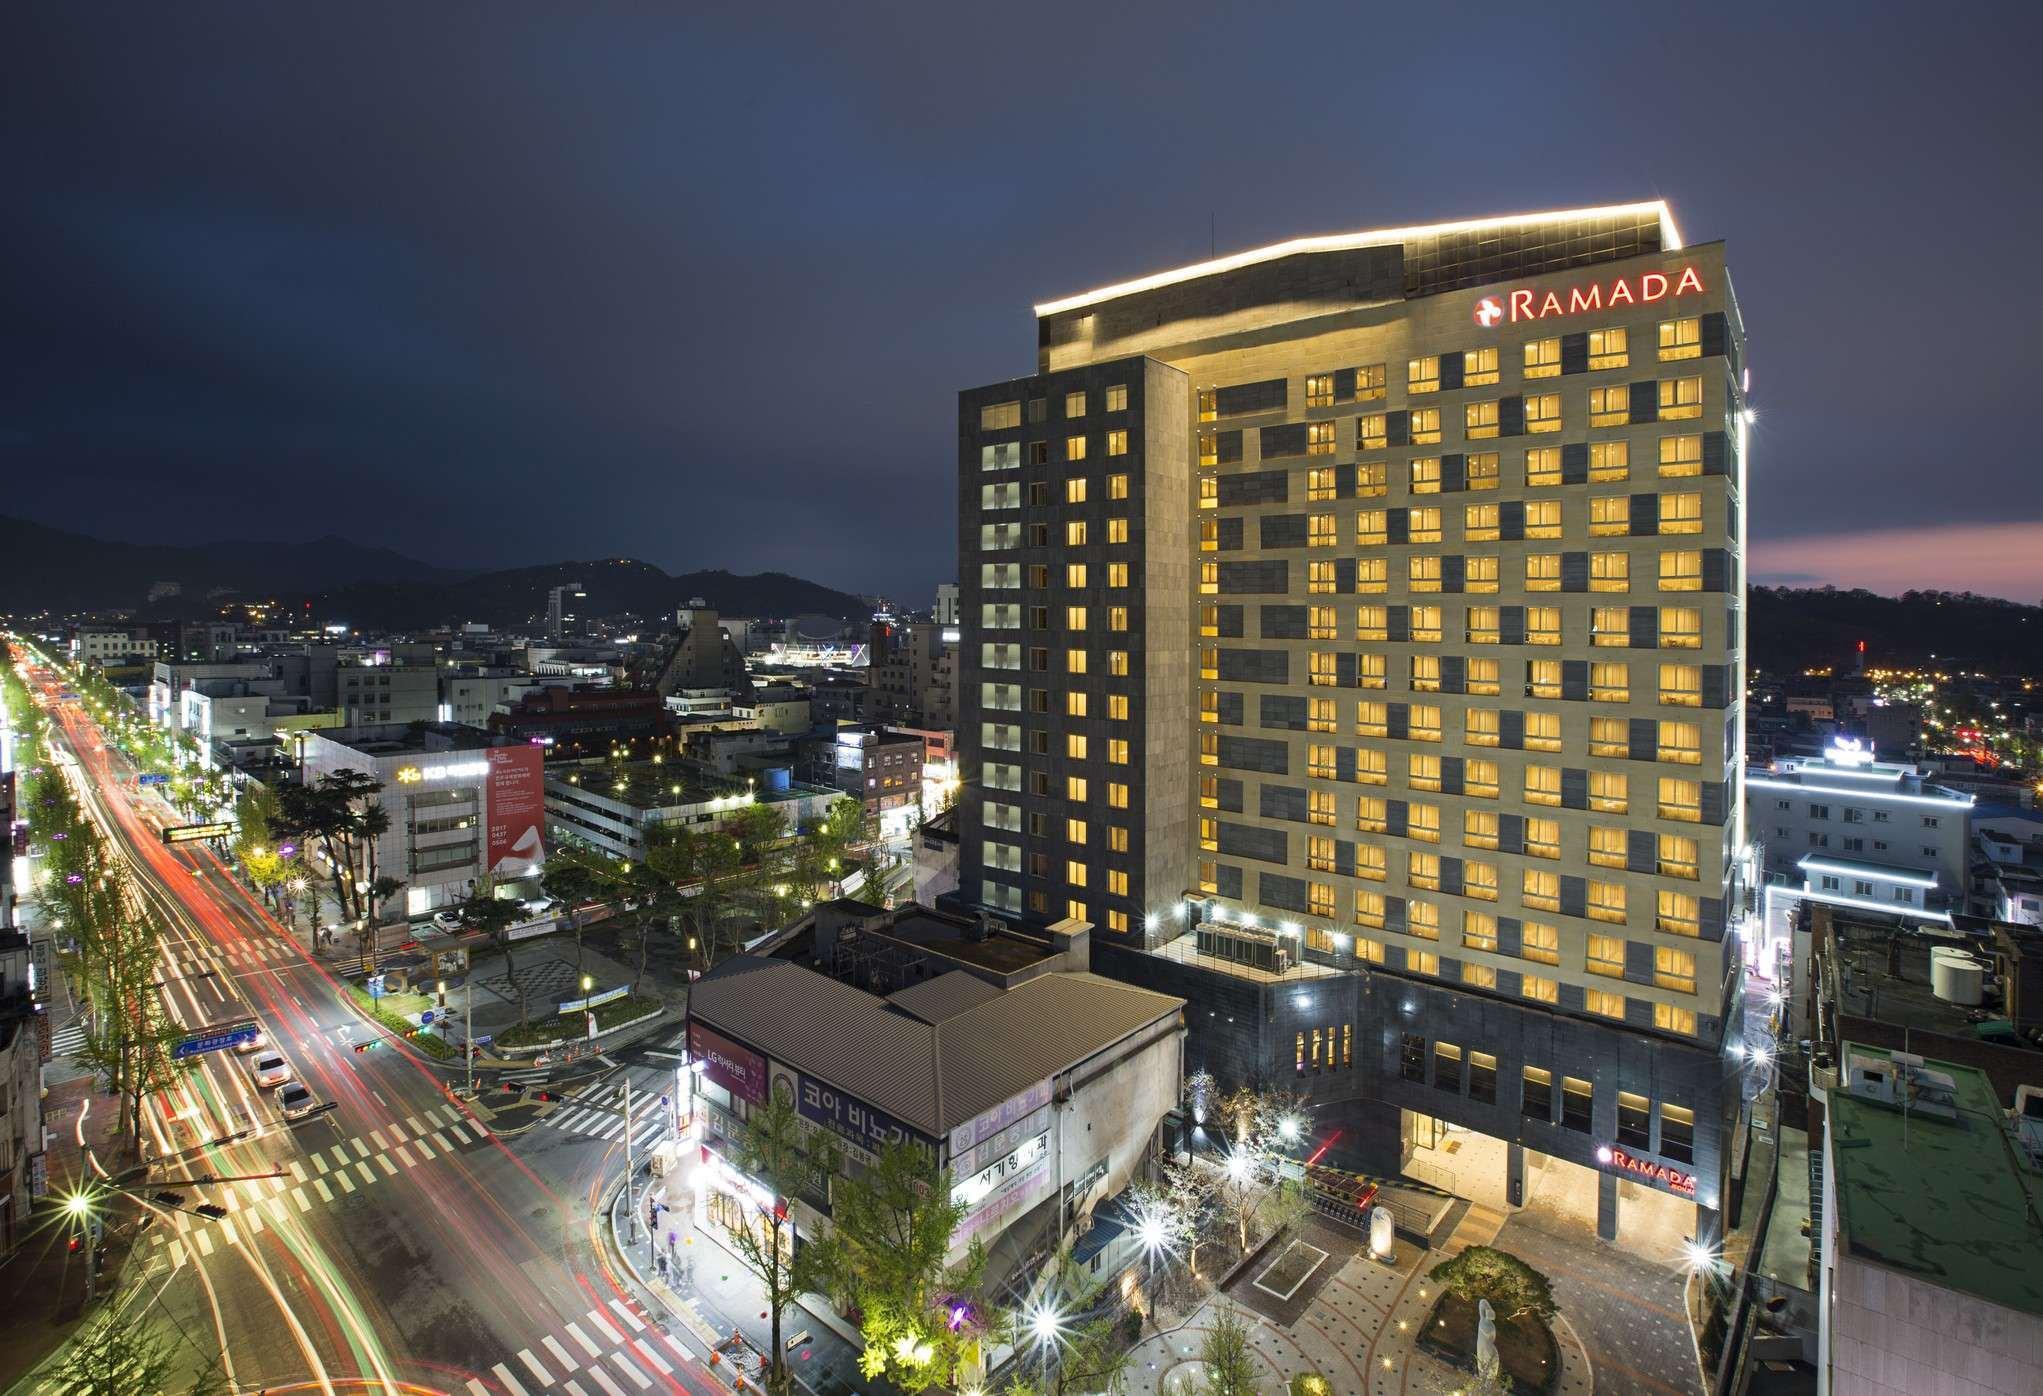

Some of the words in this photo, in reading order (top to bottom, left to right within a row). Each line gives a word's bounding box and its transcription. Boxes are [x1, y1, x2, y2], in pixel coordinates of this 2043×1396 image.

[1511, 268, 1704, 322] RAMADA
[708, 1049, 717, 1063] LG
[804, 1081, 841, 1119] 코아
[1614, 1151, 1694, 1188] RAMADA
